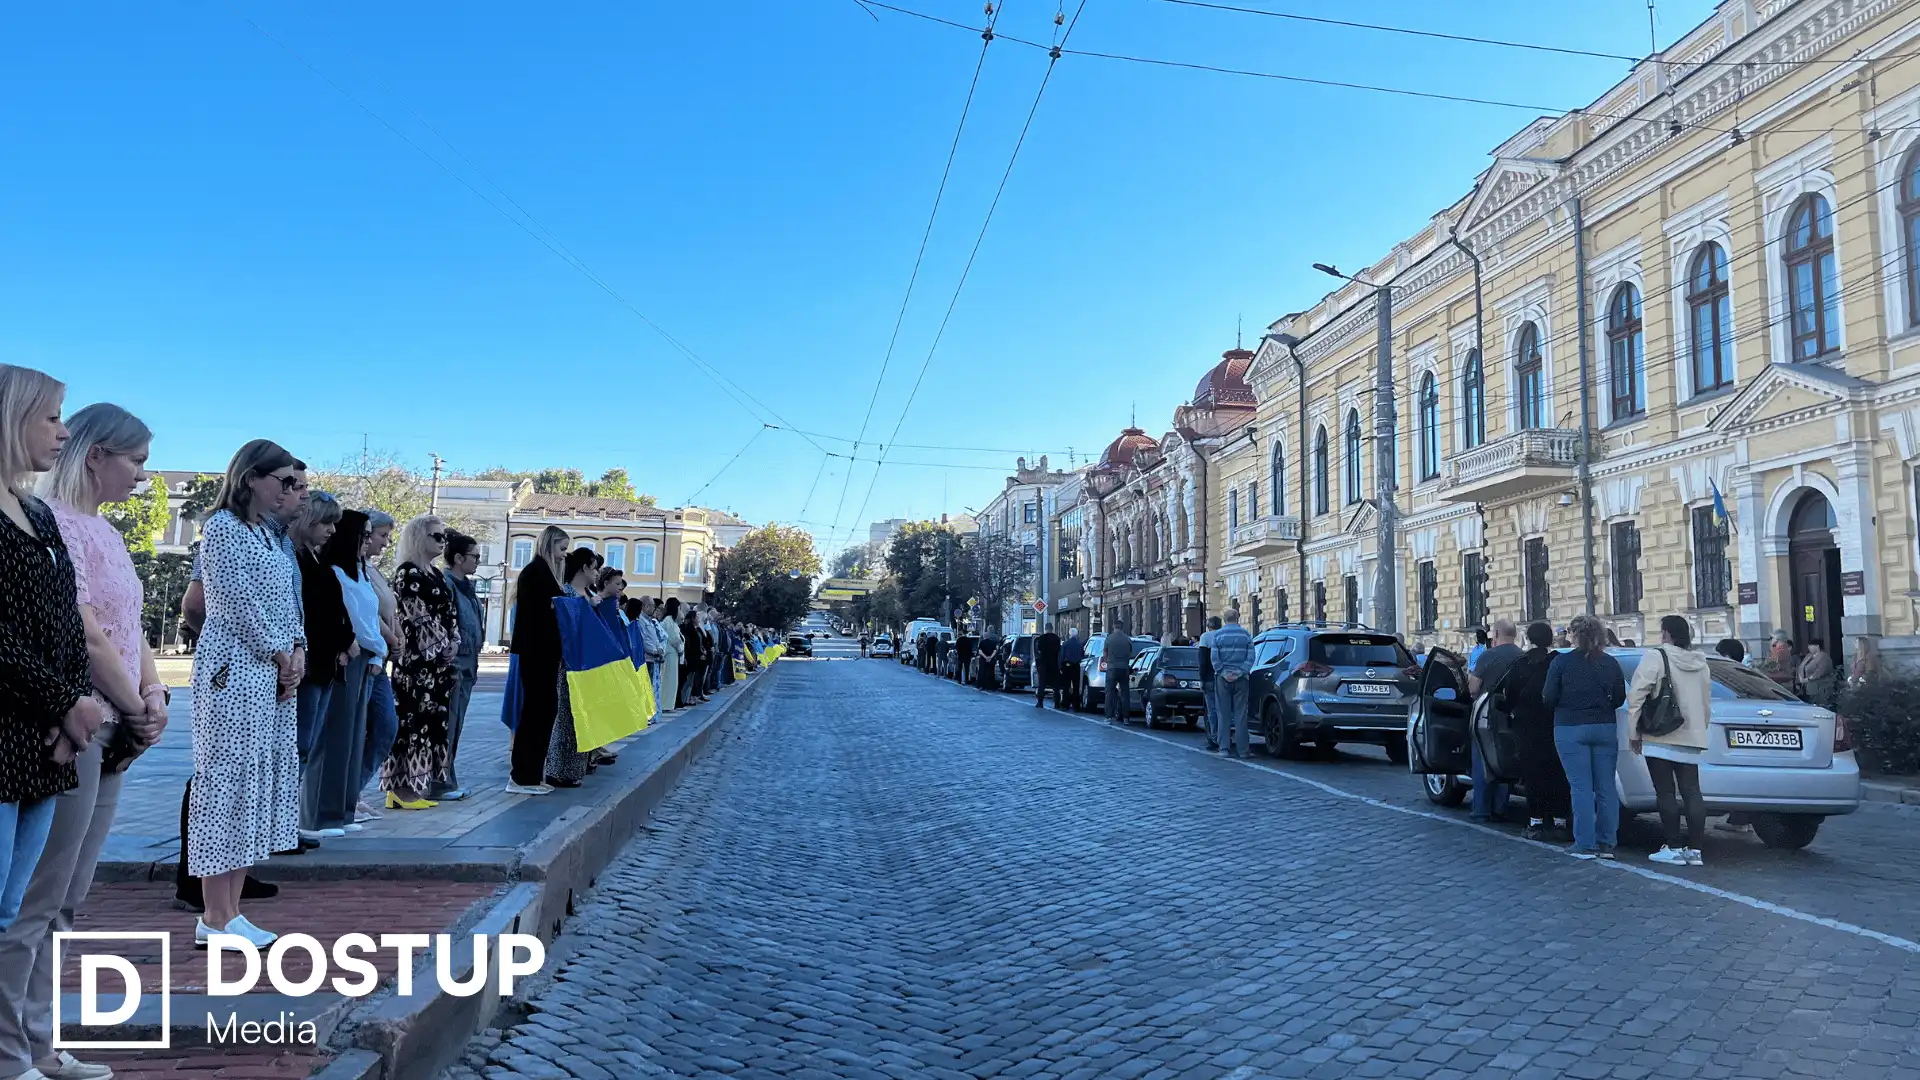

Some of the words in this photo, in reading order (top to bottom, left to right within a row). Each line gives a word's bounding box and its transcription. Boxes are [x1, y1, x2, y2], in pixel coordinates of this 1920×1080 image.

[1352, 684, 1362, 692] BA
[1737, 732, 1754, 744] BA
[1755, 733, 1780, 745] 2203
[1782, 735, 1798, 745] BB
